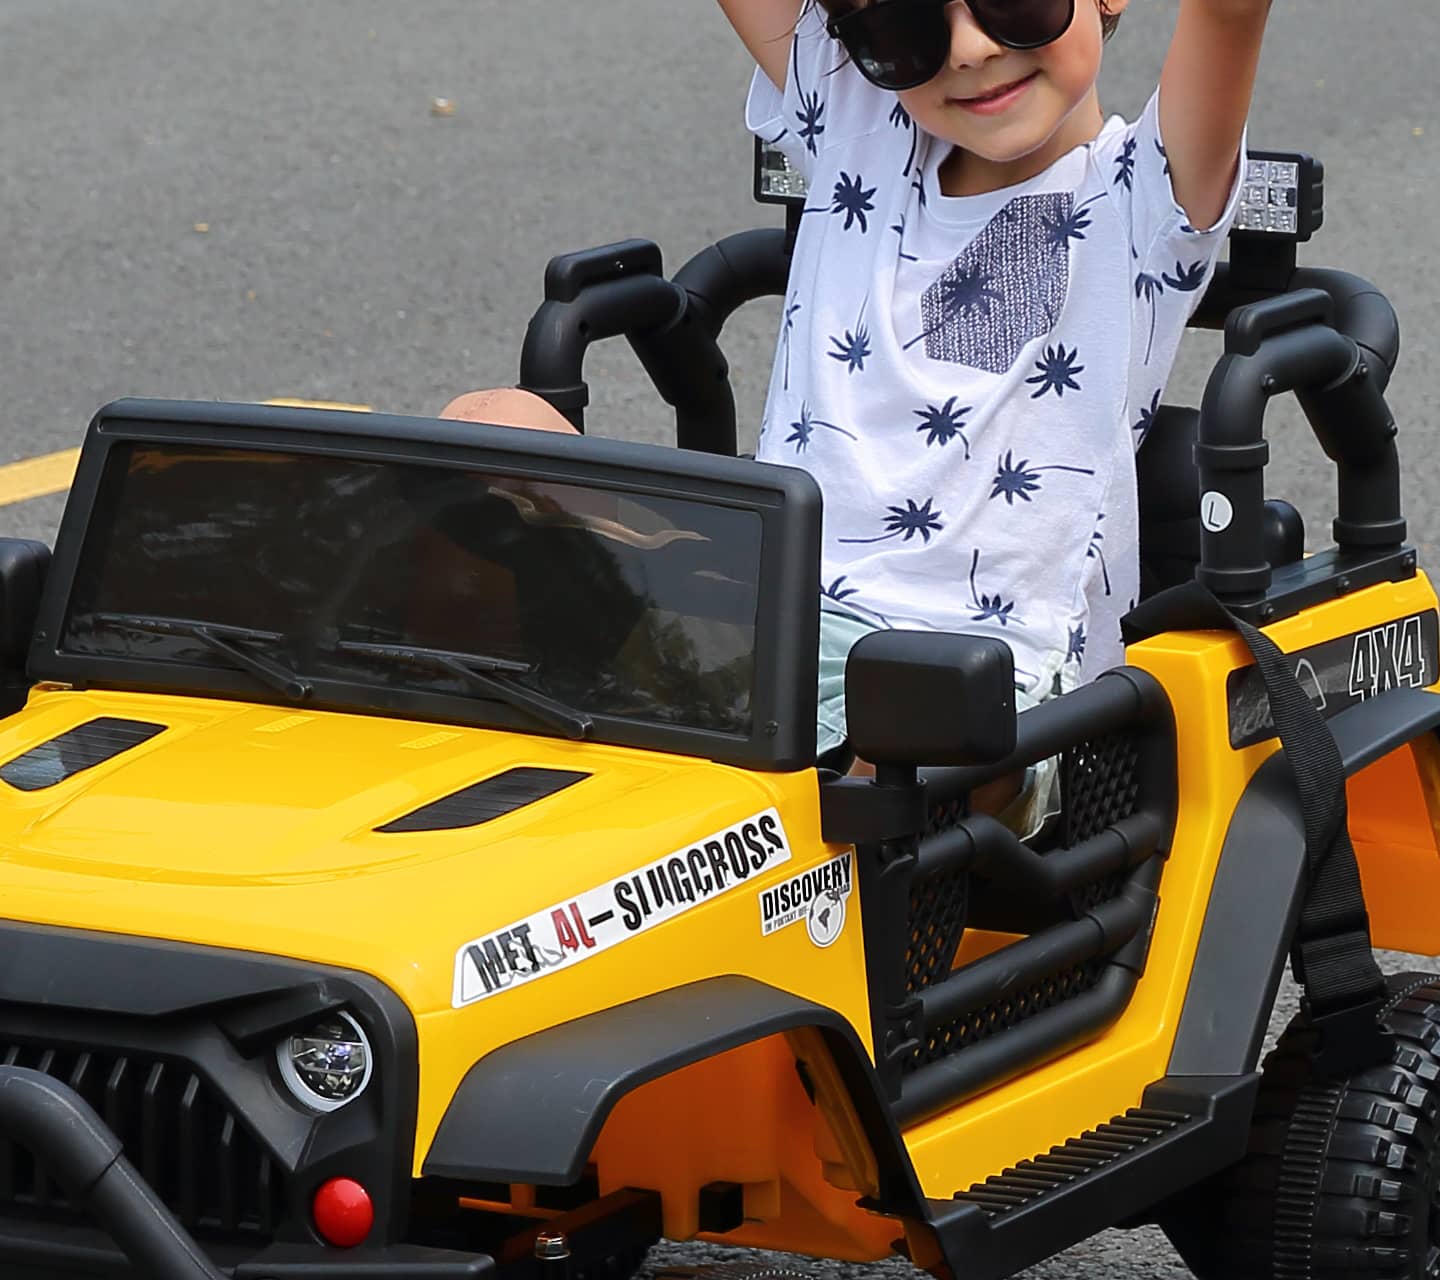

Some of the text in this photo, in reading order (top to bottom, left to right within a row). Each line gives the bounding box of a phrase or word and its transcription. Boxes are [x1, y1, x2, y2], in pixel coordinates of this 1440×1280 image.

[1208, 501, 1221, 528] L
[1349, 615, 1425, 703] 4X4
[762, 853, 851, 921] DISCOVERY
